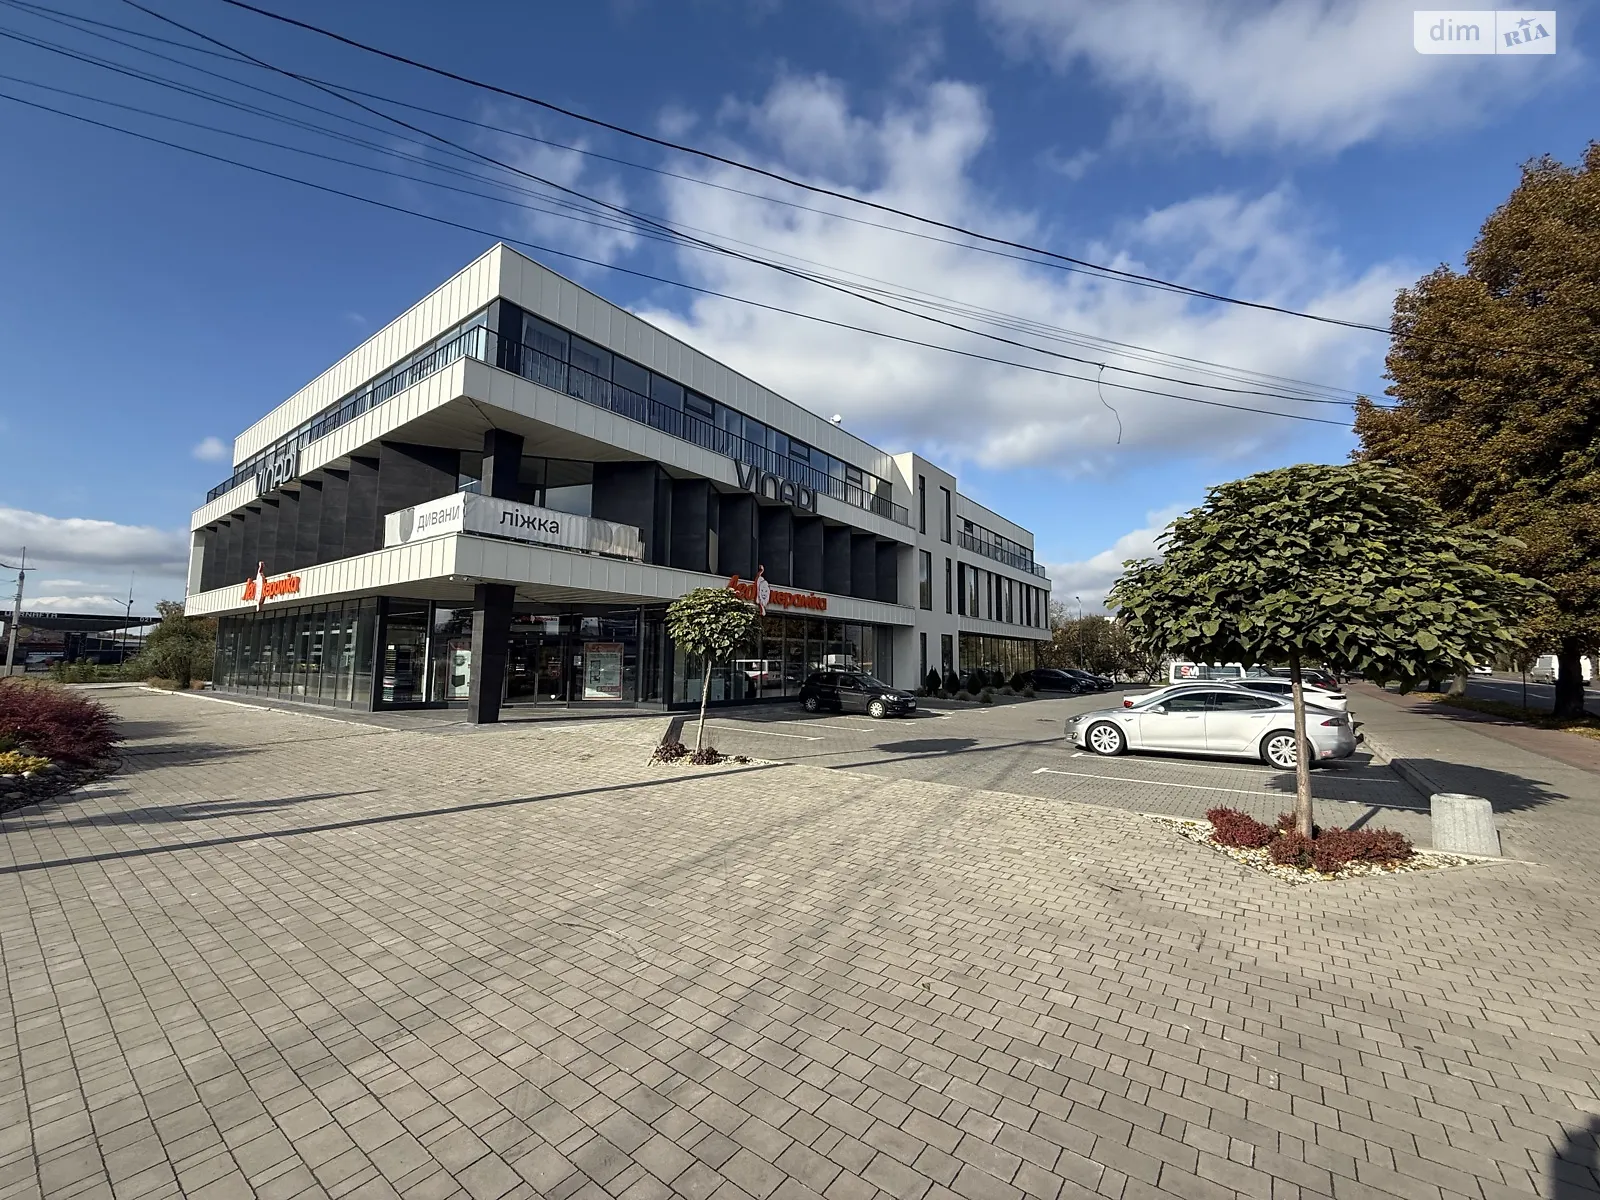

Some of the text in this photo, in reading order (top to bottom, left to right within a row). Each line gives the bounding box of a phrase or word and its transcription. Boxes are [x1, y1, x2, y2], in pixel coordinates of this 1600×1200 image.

[417, 505, 460, 532] дивани
[500, 508, 560, 535] ліжка
[1181, 665, 1200, 676] SM
